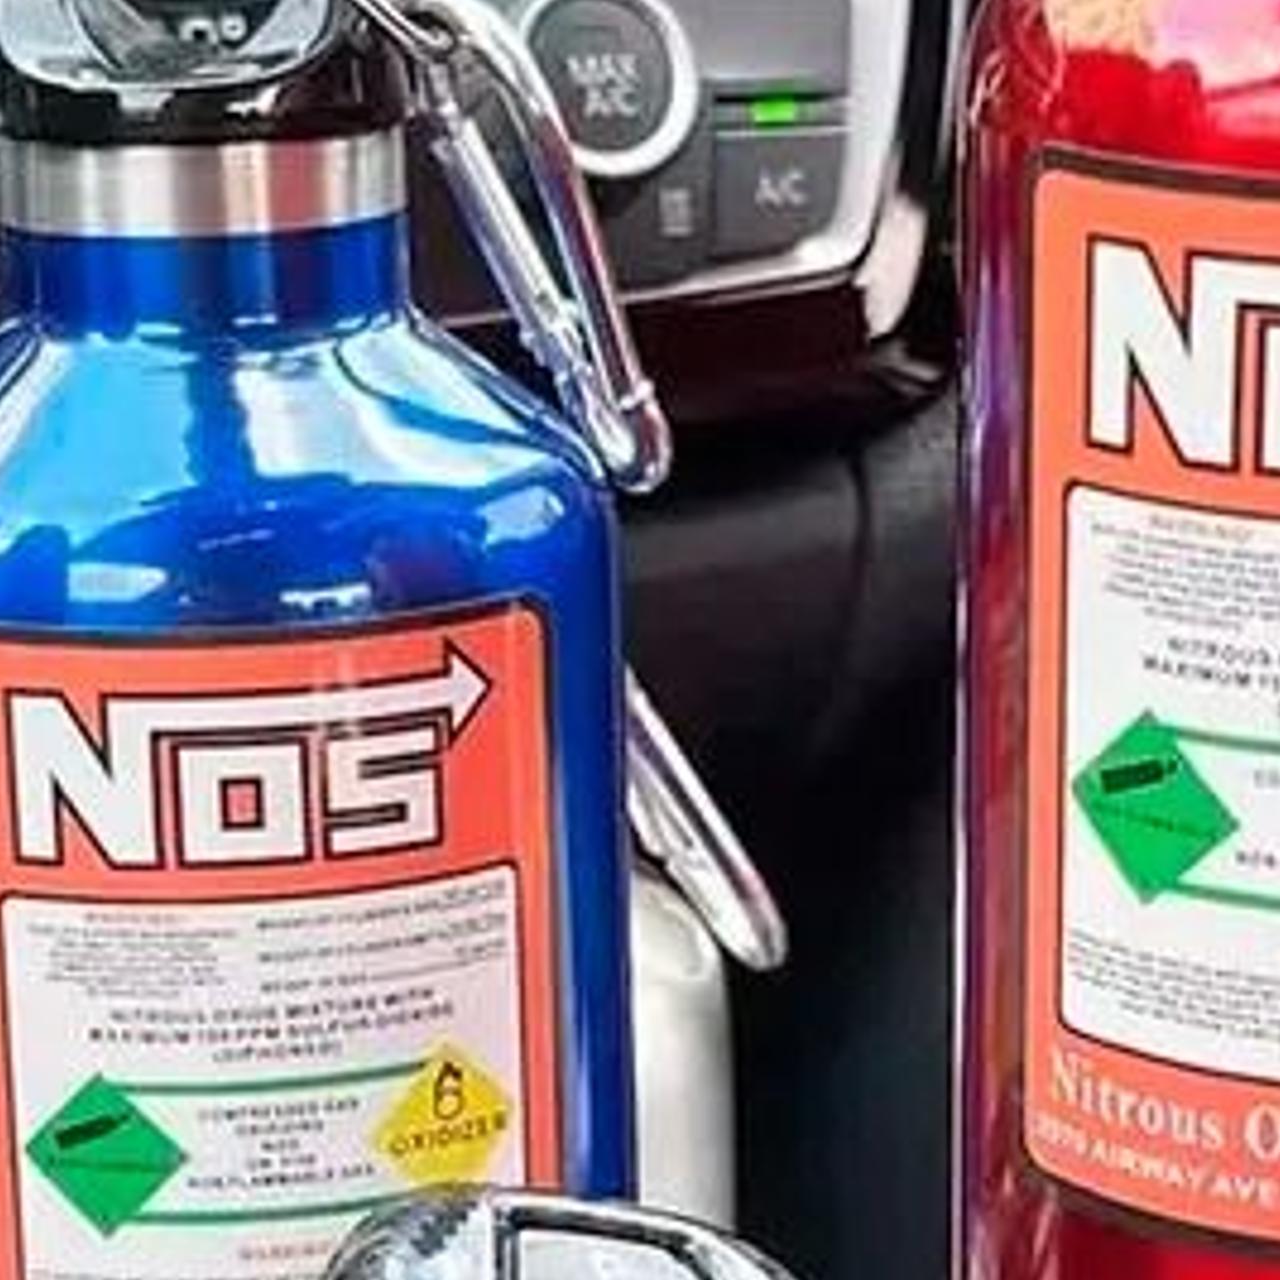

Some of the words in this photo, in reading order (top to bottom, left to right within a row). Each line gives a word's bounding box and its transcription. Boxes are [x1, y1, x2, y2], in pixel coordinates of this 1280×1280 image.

[5, 637, 493, 870] NOS
[1050, 1048, 1223, 1151] Nitrous
[1090, 1138, 1209, 1188] AIRWAY
